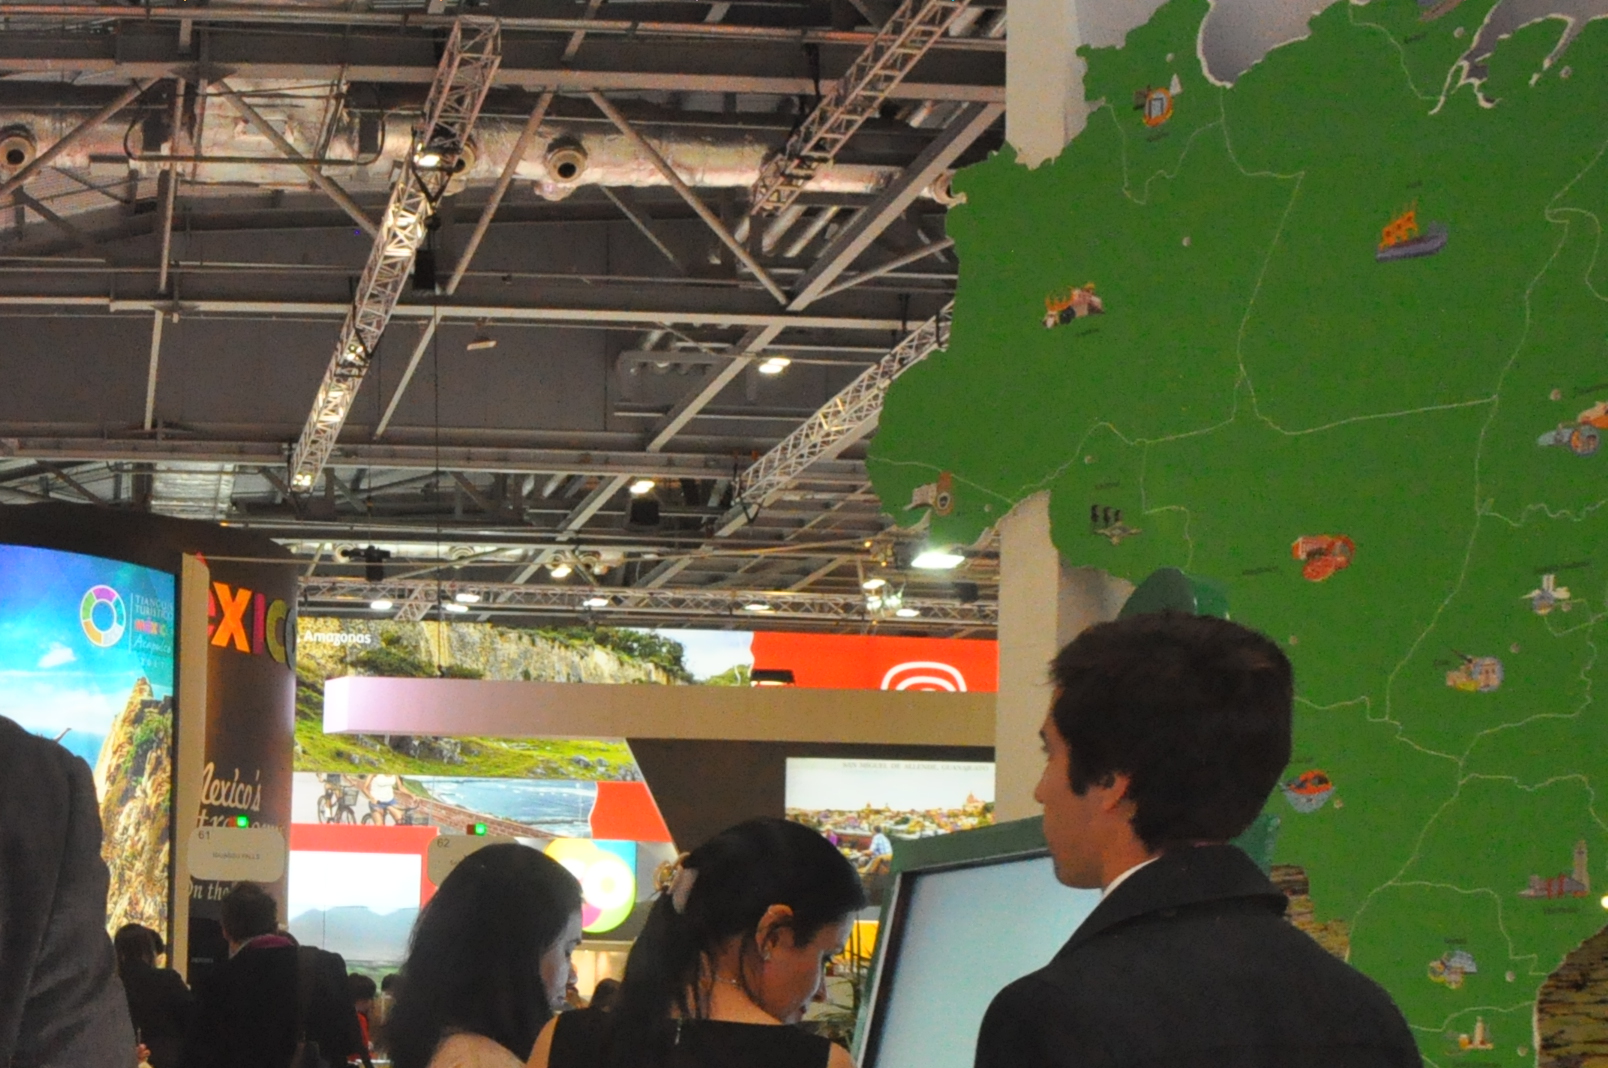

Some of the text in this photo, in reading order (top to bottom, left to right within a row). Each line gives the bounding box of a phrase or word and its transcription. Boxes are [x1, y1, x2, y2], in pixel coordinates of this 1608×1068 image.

[303, 629, 372, 646] Amazonas
[198, 831, 210, 840] 61
[437, 838, 450, 848] 62
